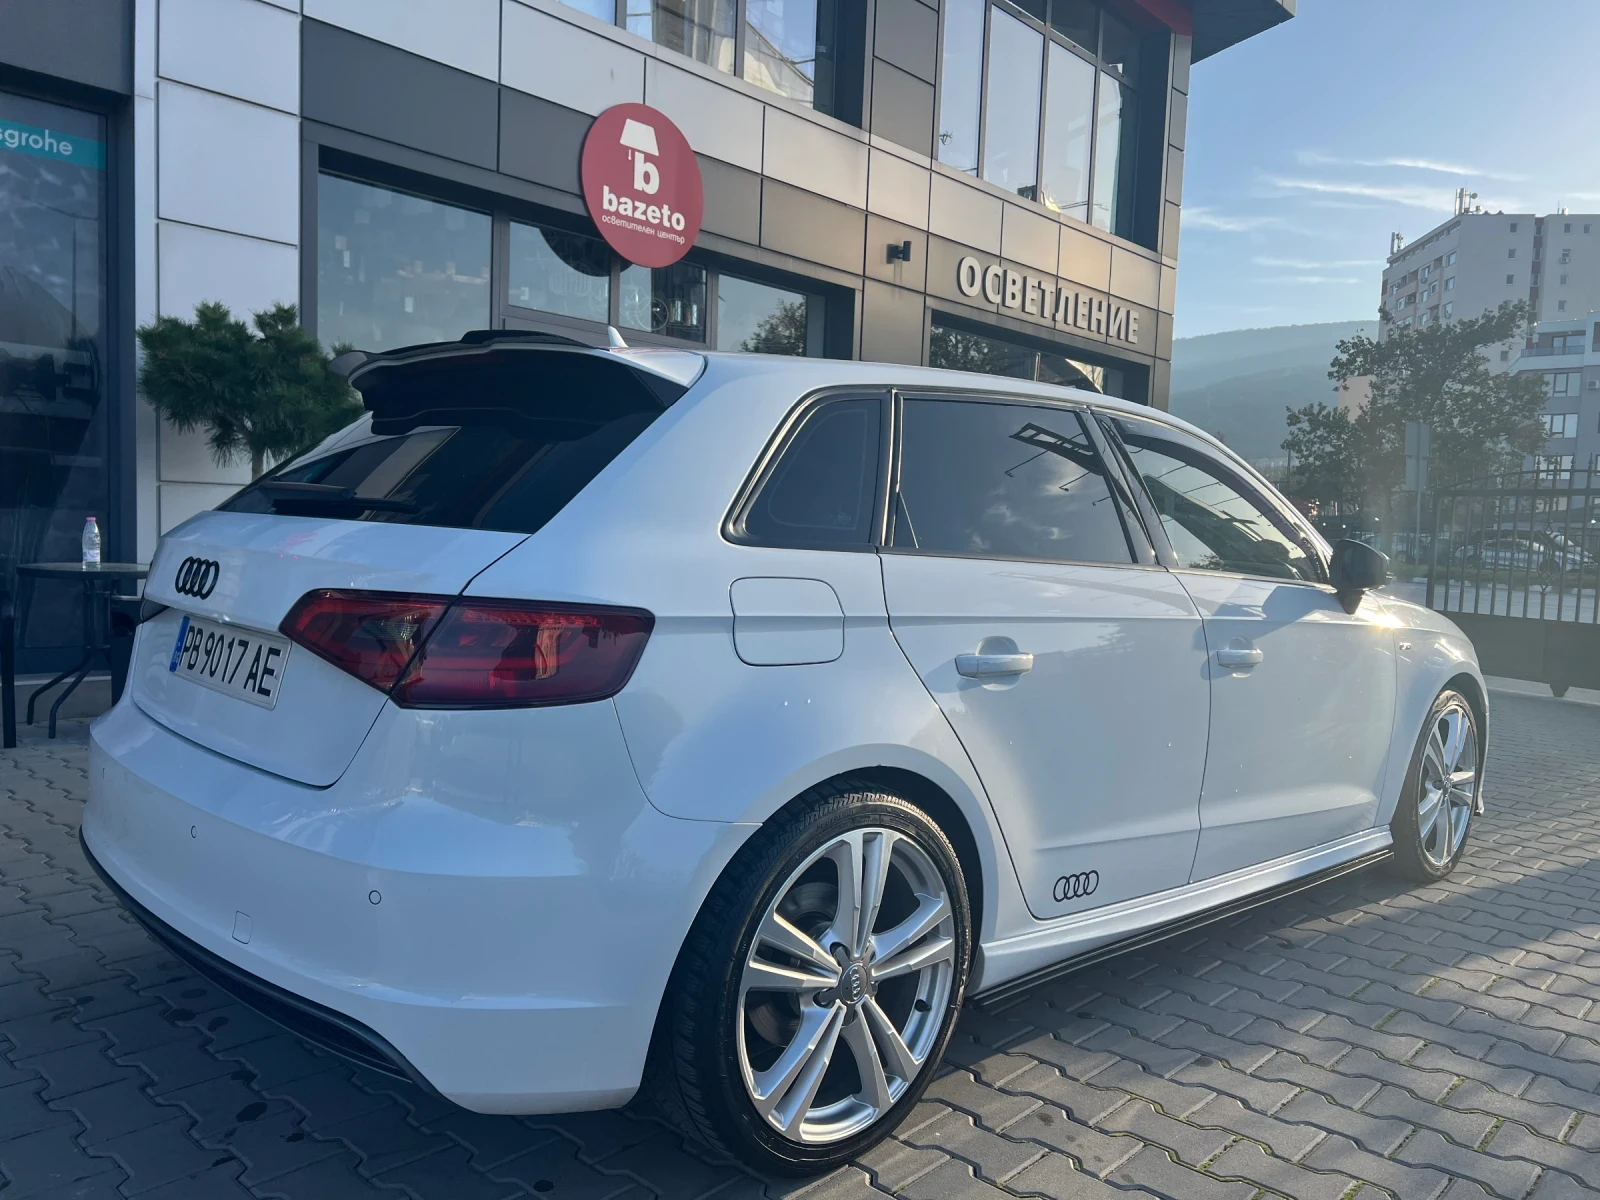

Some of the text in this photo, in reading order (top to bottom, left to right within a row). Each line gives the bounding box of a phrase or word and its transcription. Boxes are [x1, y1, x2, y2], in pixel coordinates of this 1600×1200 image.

[601, 214, 686, 245] осветителен център
[602, 185, 686, 231] bazeto
[957, 256, 1140, 344] ОСВЕТЛЕНИЕ
[200, 631, 250, 685] 9017
